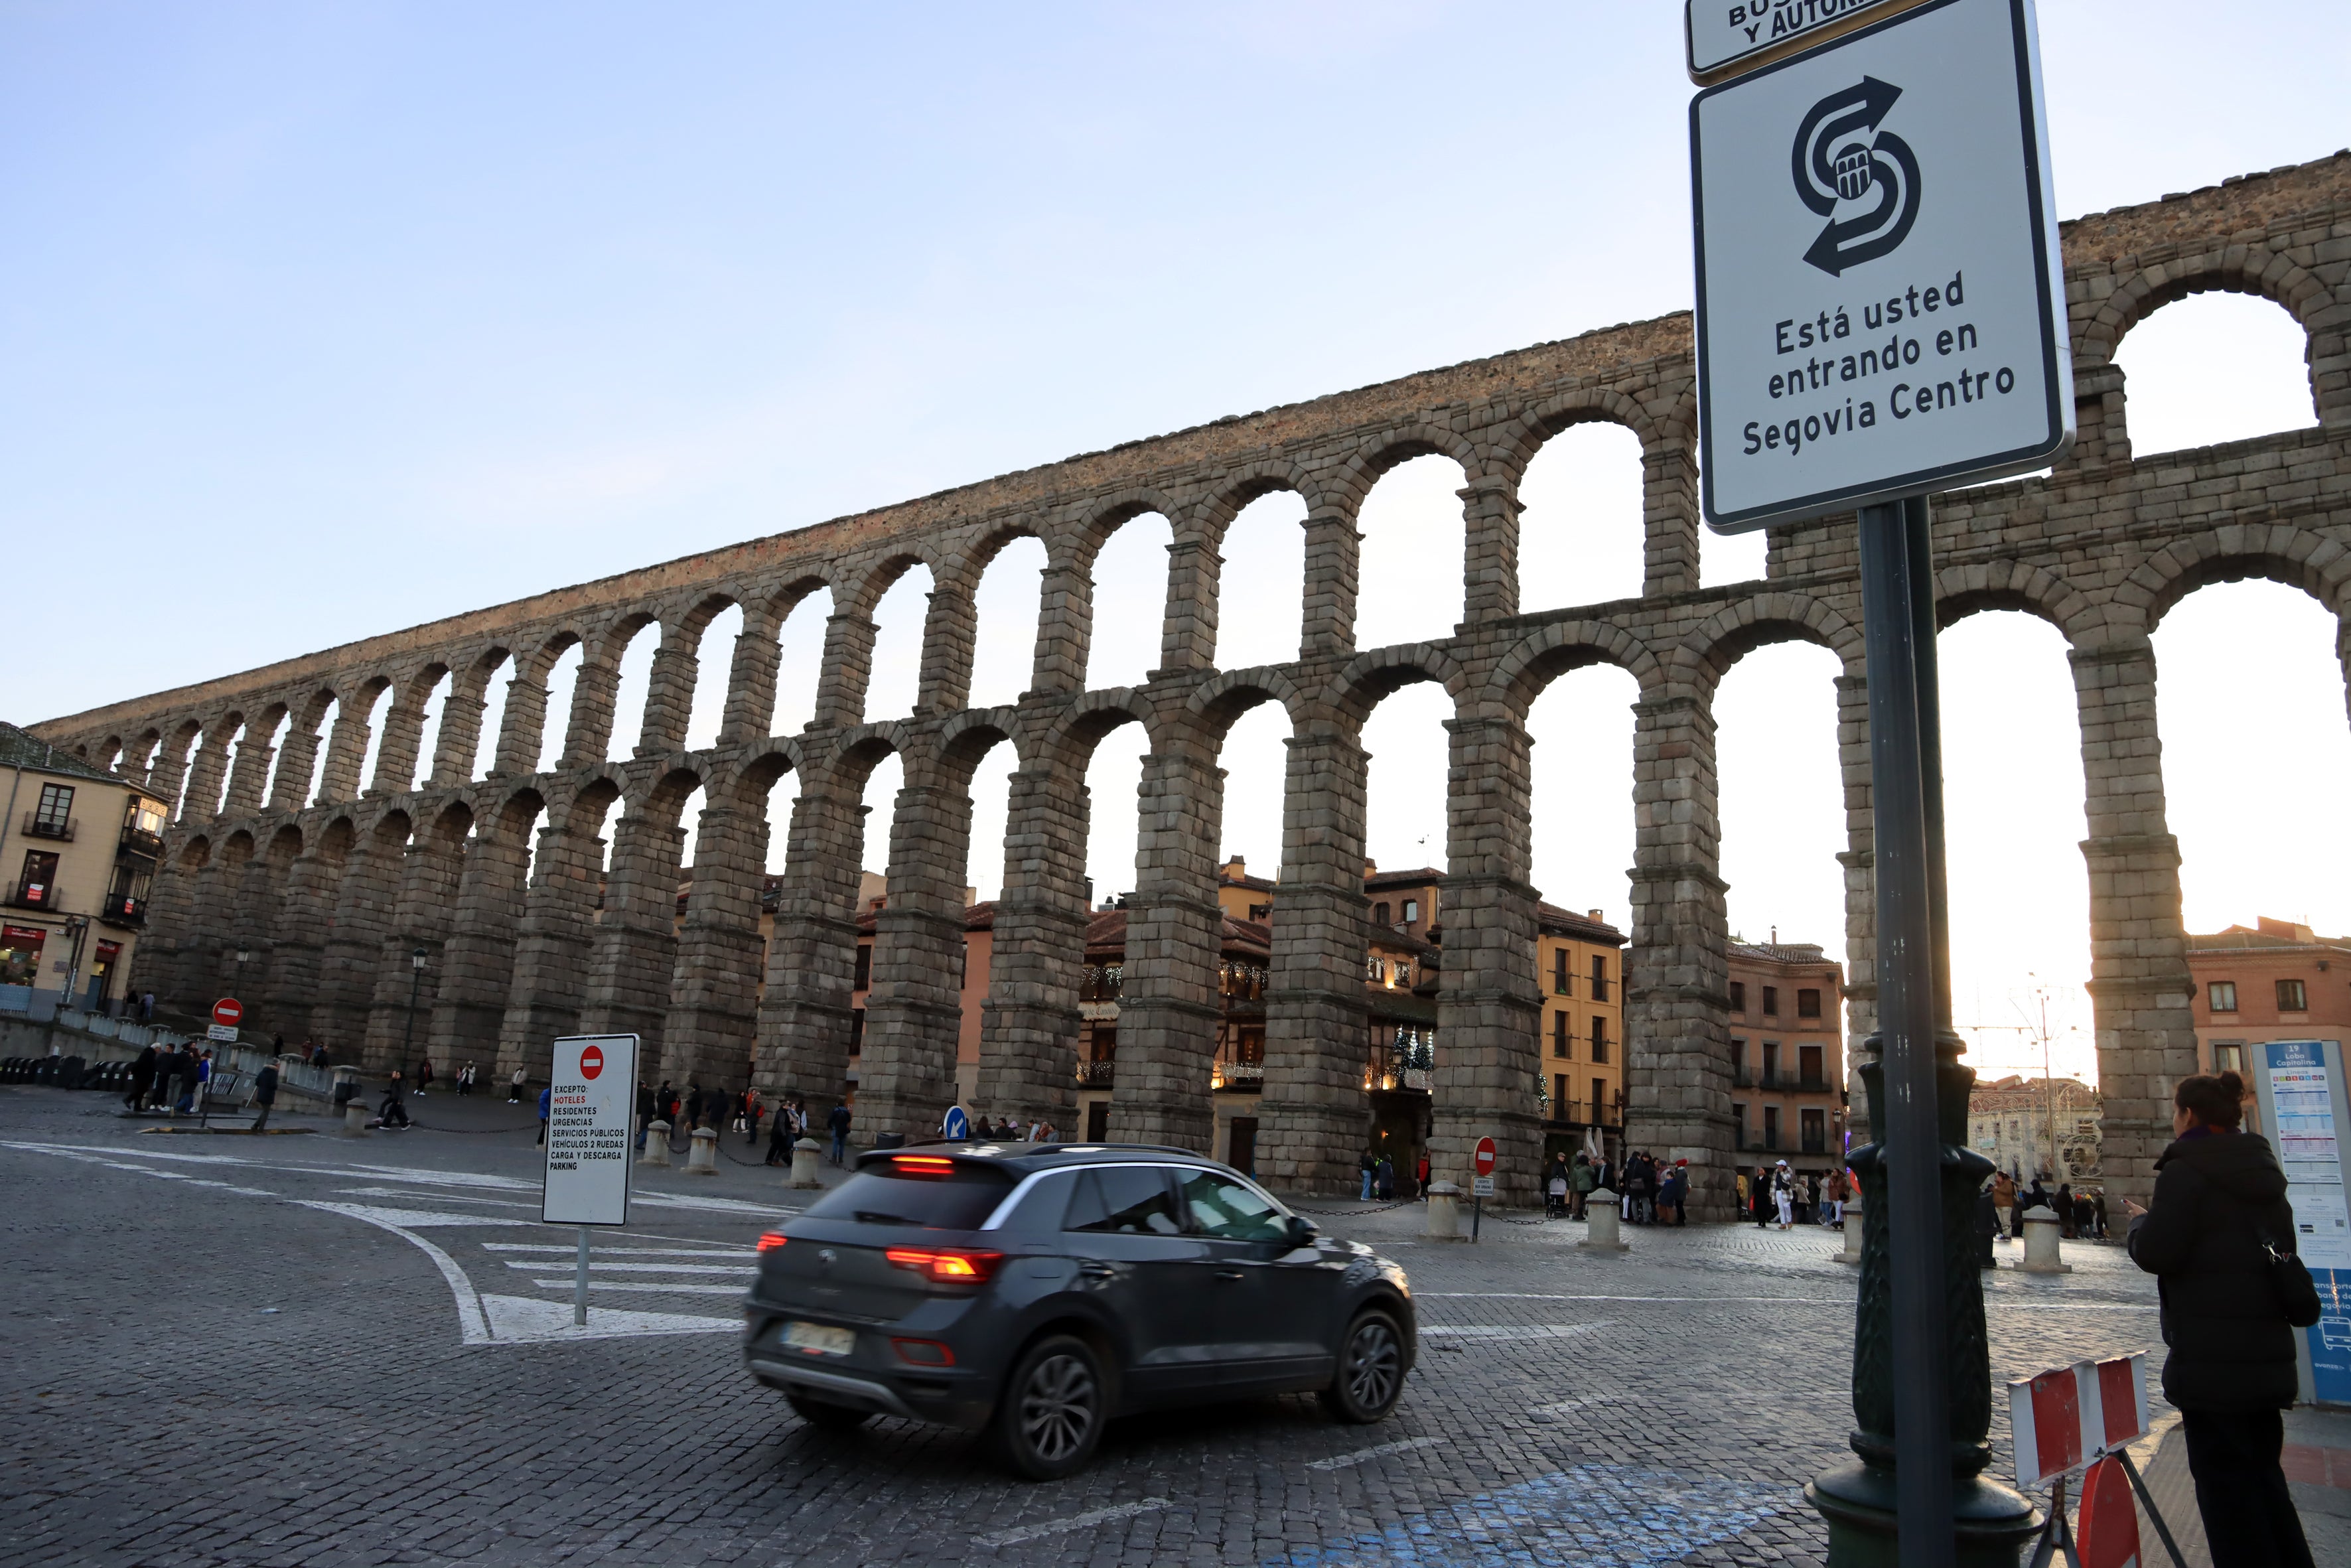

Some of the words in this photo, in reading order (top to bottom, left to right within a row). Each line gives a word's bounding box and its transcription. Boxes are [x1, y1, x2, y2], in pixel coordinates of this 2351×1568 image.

[1743, 22, 1760, 44] Y
[1776, 305, 1850, 355] Está
[1864, 269, 1964, 330] usted
[1768, 334, 1920, 399] entrando
[1936, 323, 1977, 356] en
[1743, 398, 1876, 457] Segovia
[1890, 367, 2015, 420] Centro
[555, 1085, 589, 1094] EXCEPTO:
[554, 1096, 586, 1104] HOTELES
[590, 1127, 624, 1137] PÚBLICOS
[551, 1139, 589, 1148] VEHÍCULOS
[549, 1162, 577, 1171] PARKING
